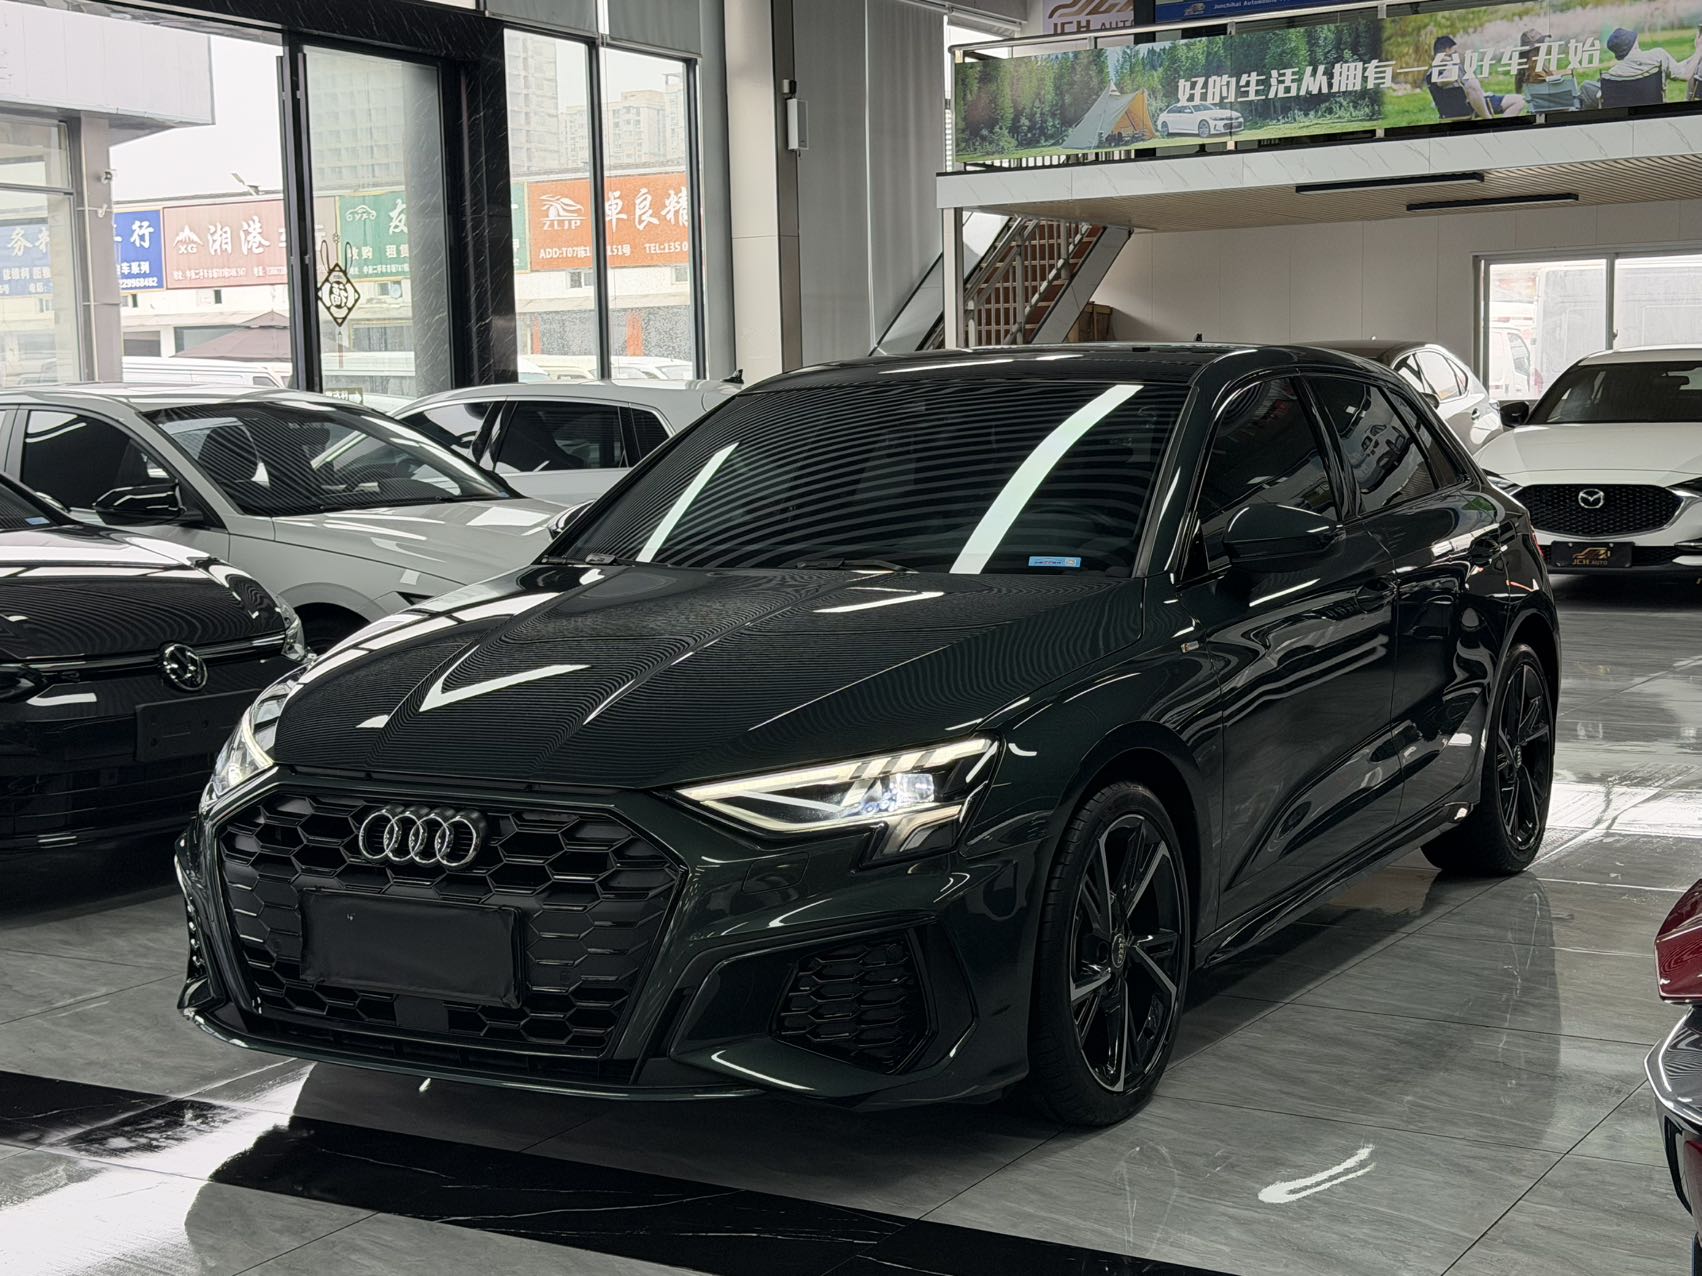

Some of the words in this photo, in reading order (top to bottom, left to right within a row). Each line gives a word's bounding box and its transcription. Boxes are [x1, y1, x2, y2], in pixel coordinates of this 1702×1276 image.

[1100, 19, 1135, 31] AUT
[1178, 37, 1600, 105] 好的生活从拥有一台好车开始
